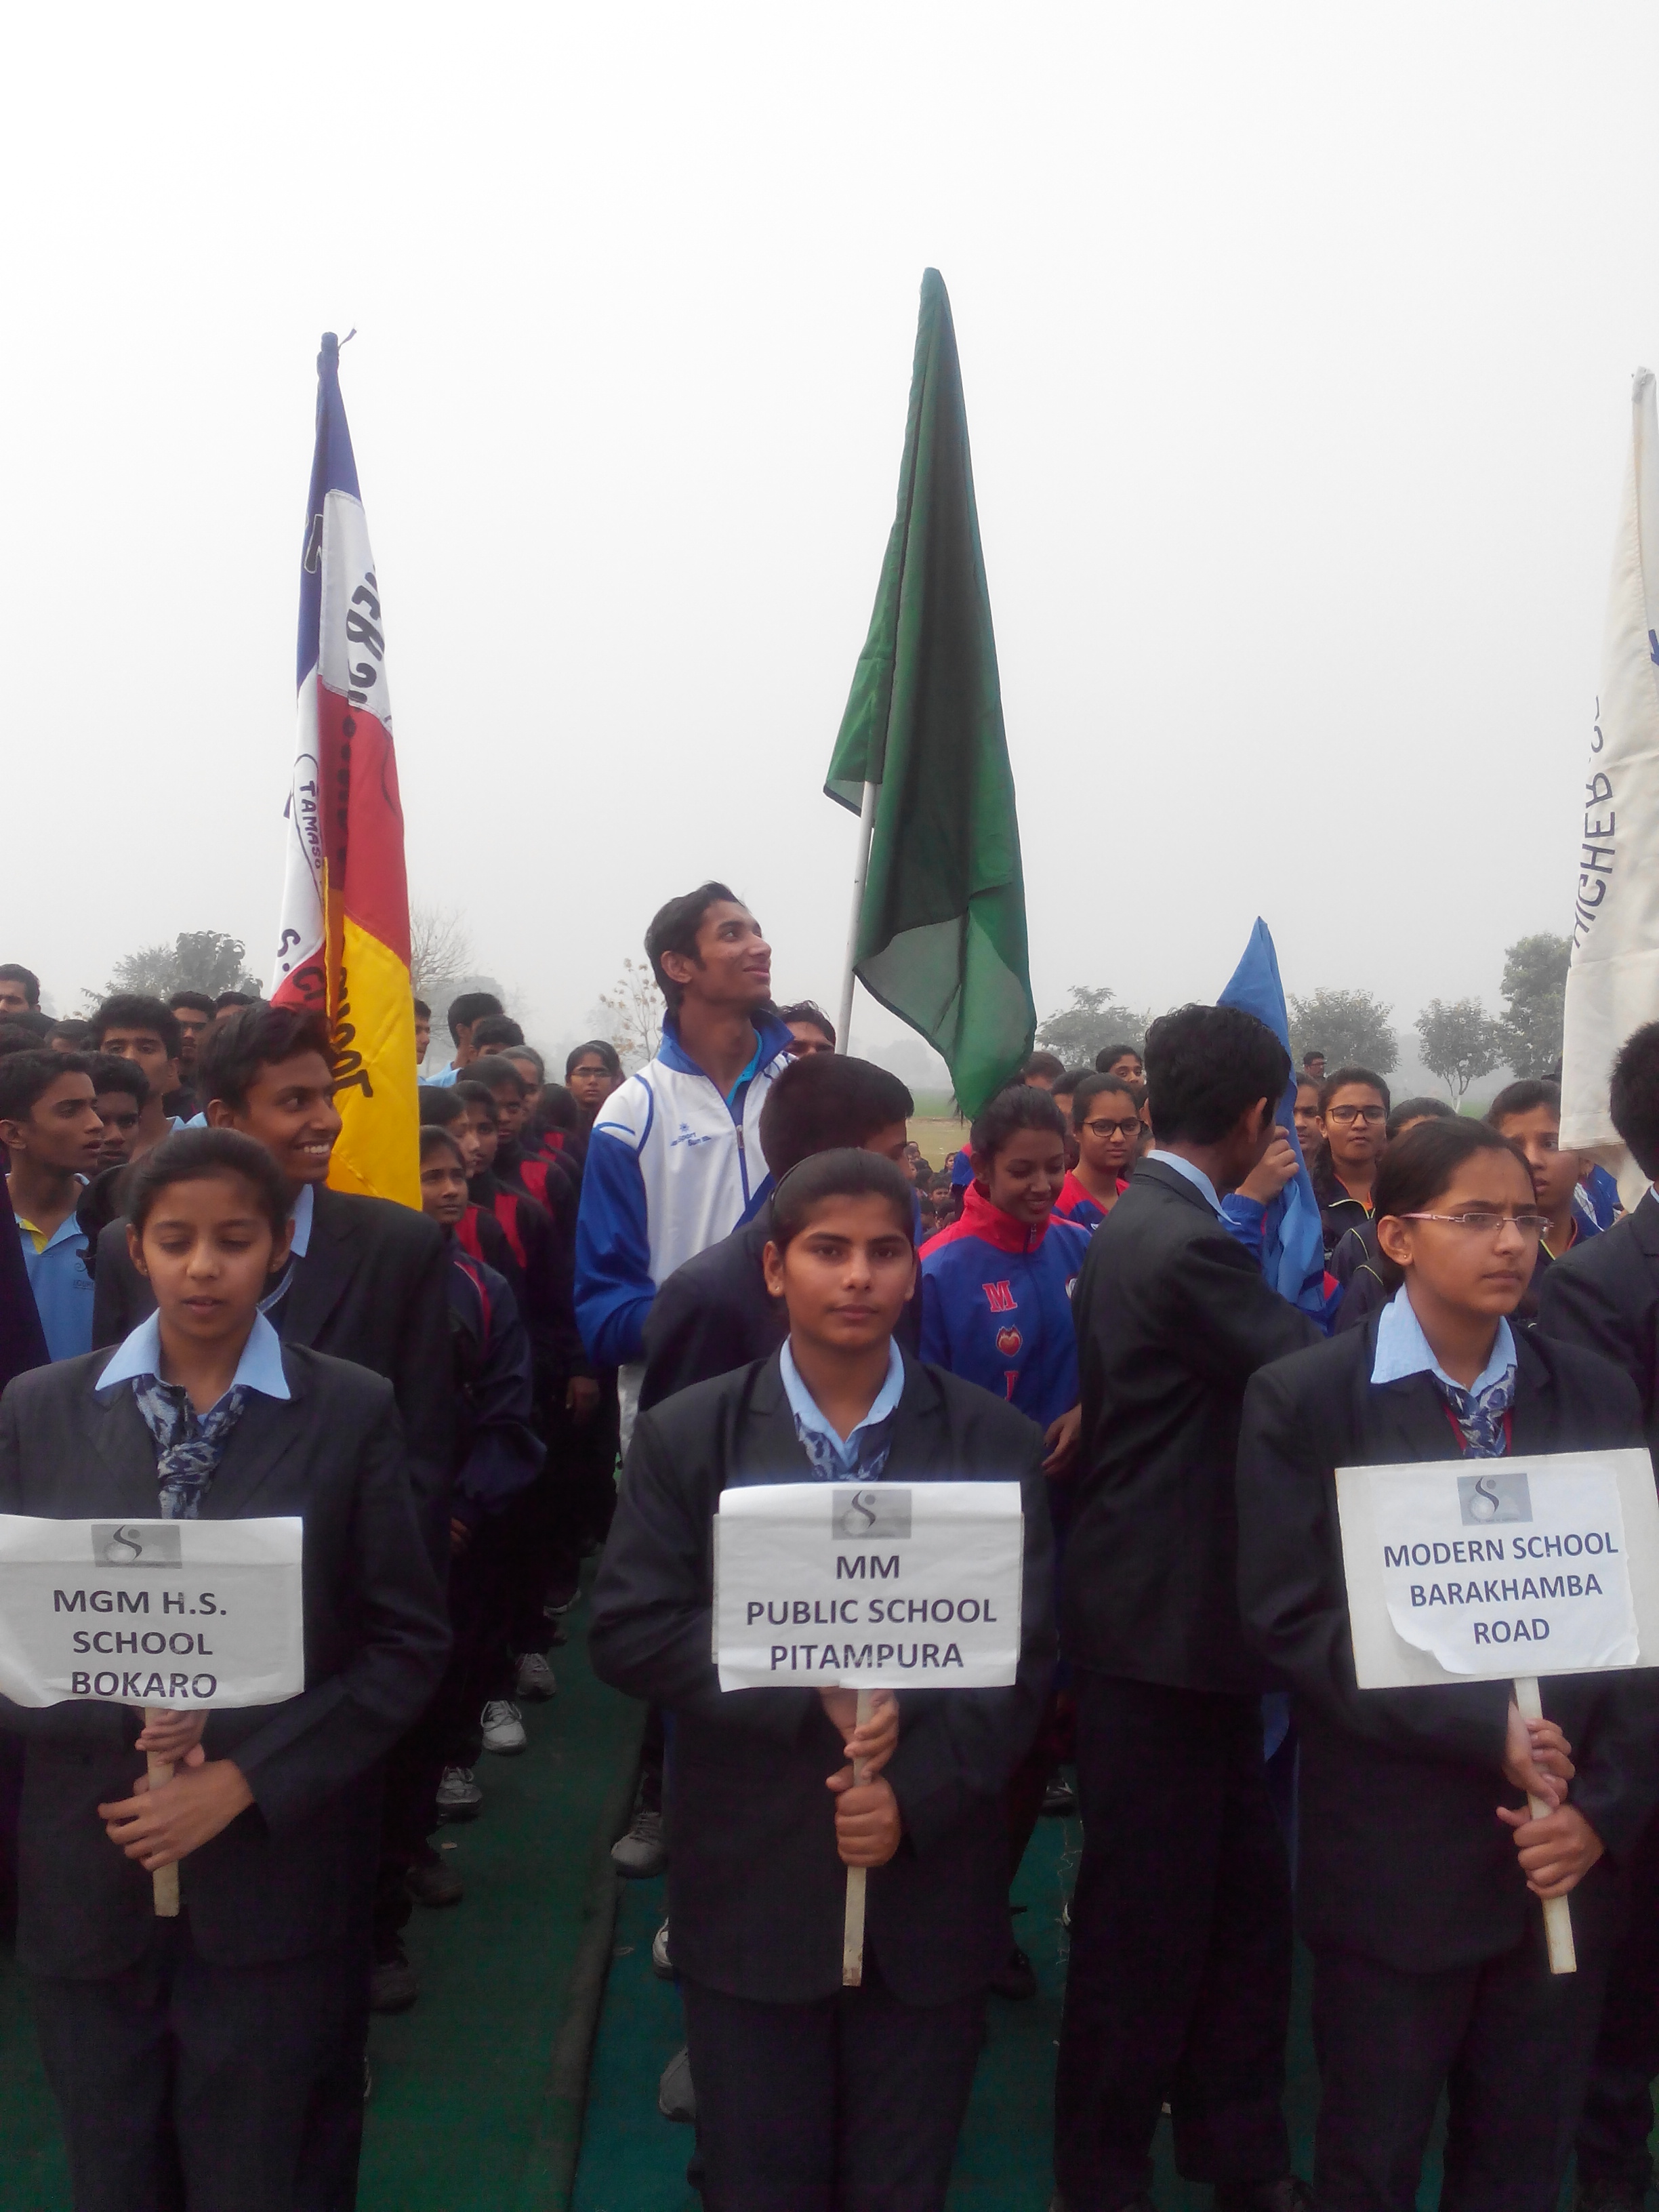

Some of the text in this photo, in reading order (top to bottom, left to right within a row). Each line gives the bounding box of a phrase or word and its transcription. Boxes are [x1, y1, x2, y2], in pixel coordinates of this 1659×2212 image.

[1384, 1532, 1619, 1568] MODERN SCHOOL
[836, 1555, 900, 1580] MM
[53, 1590, 227, 1616] MGM H.S.
[1410, 1573, 1603, 1607] BARAKHAMBA
[747, 1598, 998, 1626] PUBLIC SCHOOL
[73, 1631, 213, 1656] SCHOOL
[1473, 1618, 1550, 1645] ROAD
[770, 1643, 964, 1671] PITAMPURA
[72, 1671, 218, 1698] BOKARO
